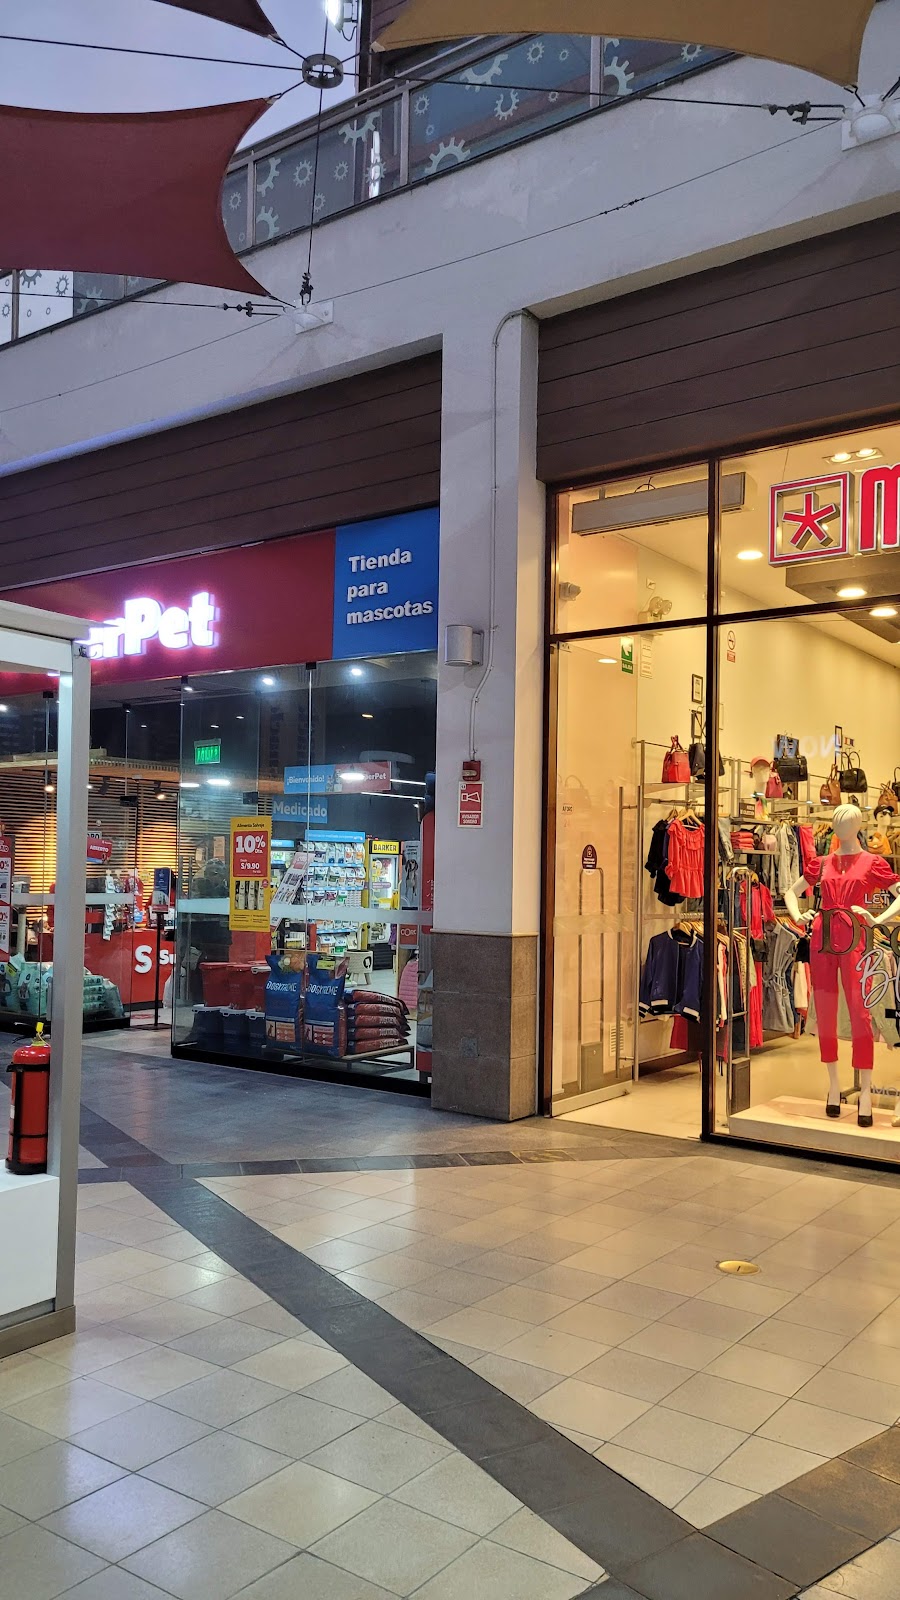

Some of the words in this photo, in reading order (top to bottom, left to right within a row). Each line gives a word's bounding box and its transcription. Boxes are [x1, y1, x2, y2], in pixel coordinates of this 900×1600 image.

[348, 547, 413, 573] Tienda
[346, 581, 388, 603] para
[346, 600, 434, 625] mascotas
[272, 800, 327, 818] Medicado
[235, 834, 266, 854] 10%
[373, 843, 397, 852] BARKER
[134, 945, 153, 974] S
